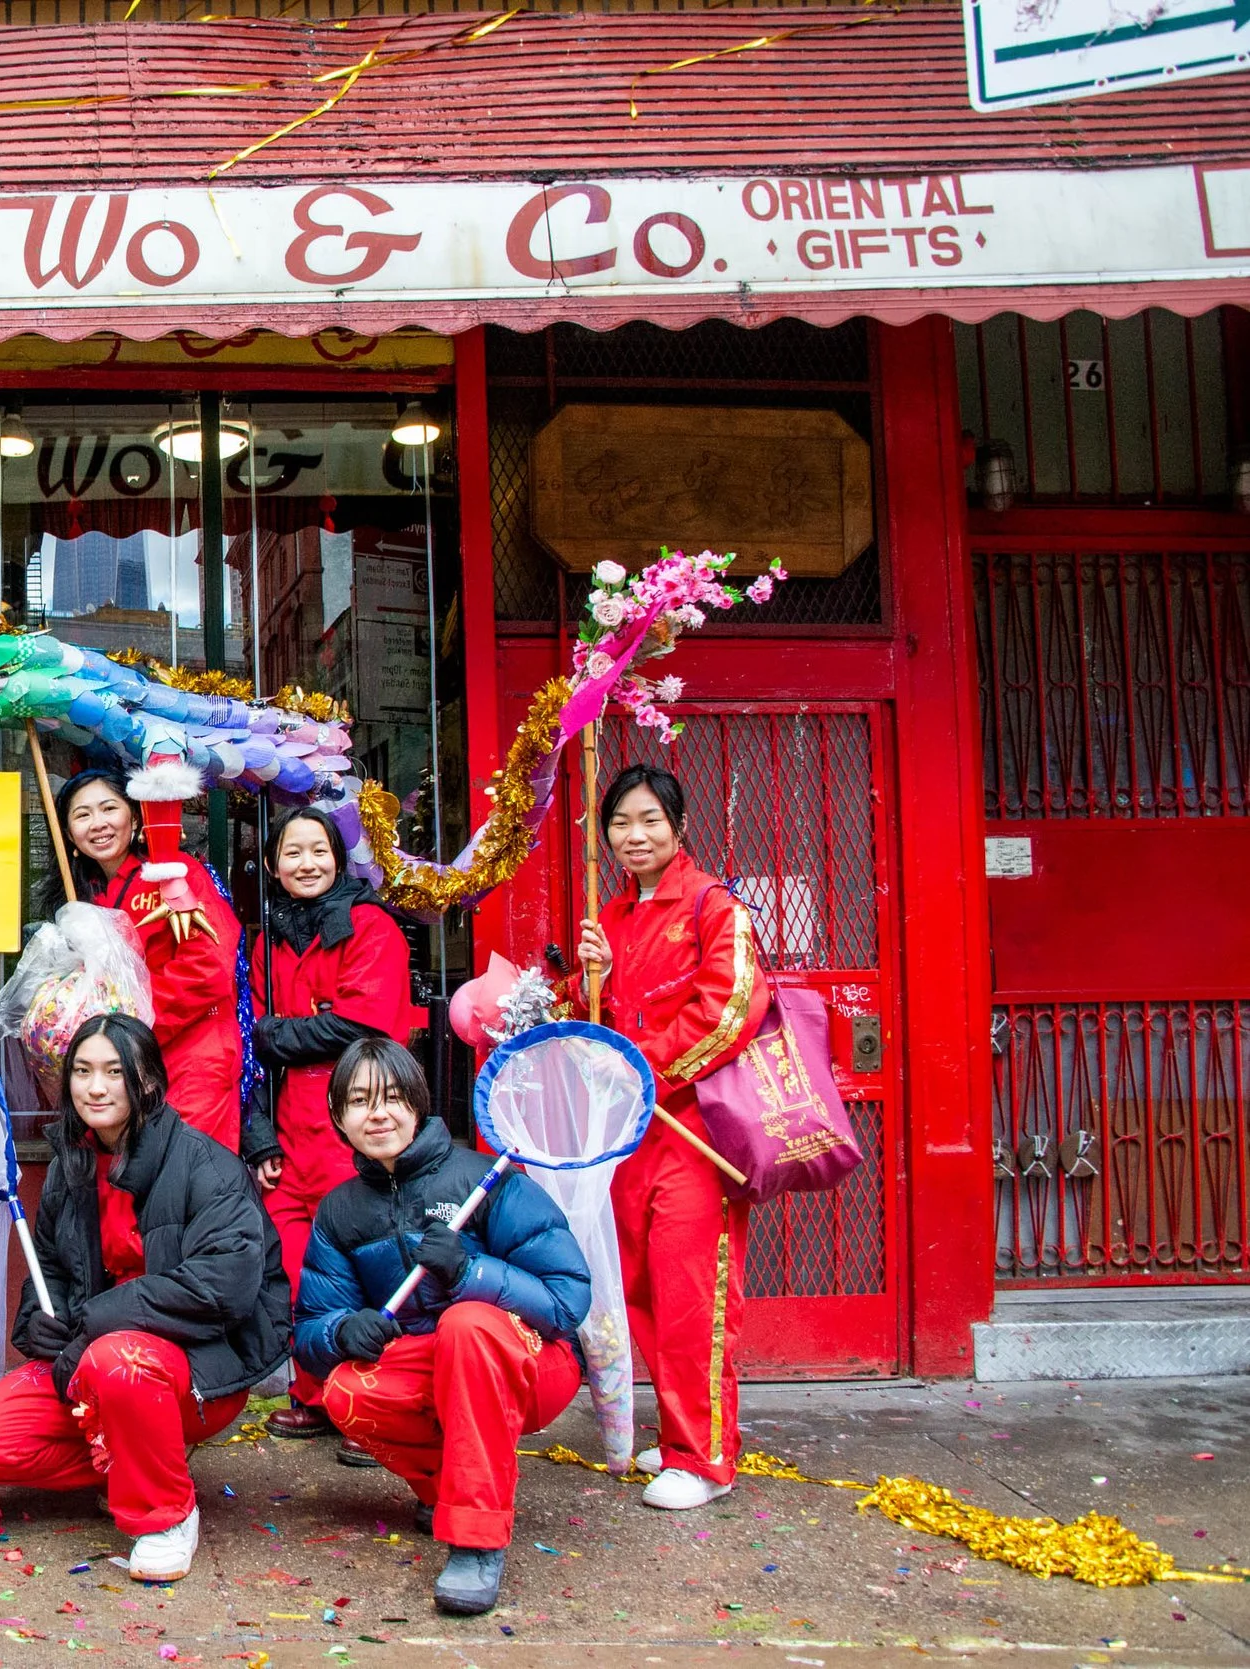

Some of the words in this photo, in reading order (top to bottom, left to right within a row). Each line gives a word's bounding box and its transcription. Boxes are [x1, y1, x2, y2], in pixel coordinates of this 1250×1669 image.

[741, 173, 995, 222] ORIENTAL
[284, 185, 423, 286] &
[506, 183, 728, 280] Co.
[796, 224, 963, 271] GIFTS
[1068, 361, 1103, 389] 26
[425, 1208, 453, 1217] NORTH
[436, 1202, 452, 1210] THE
